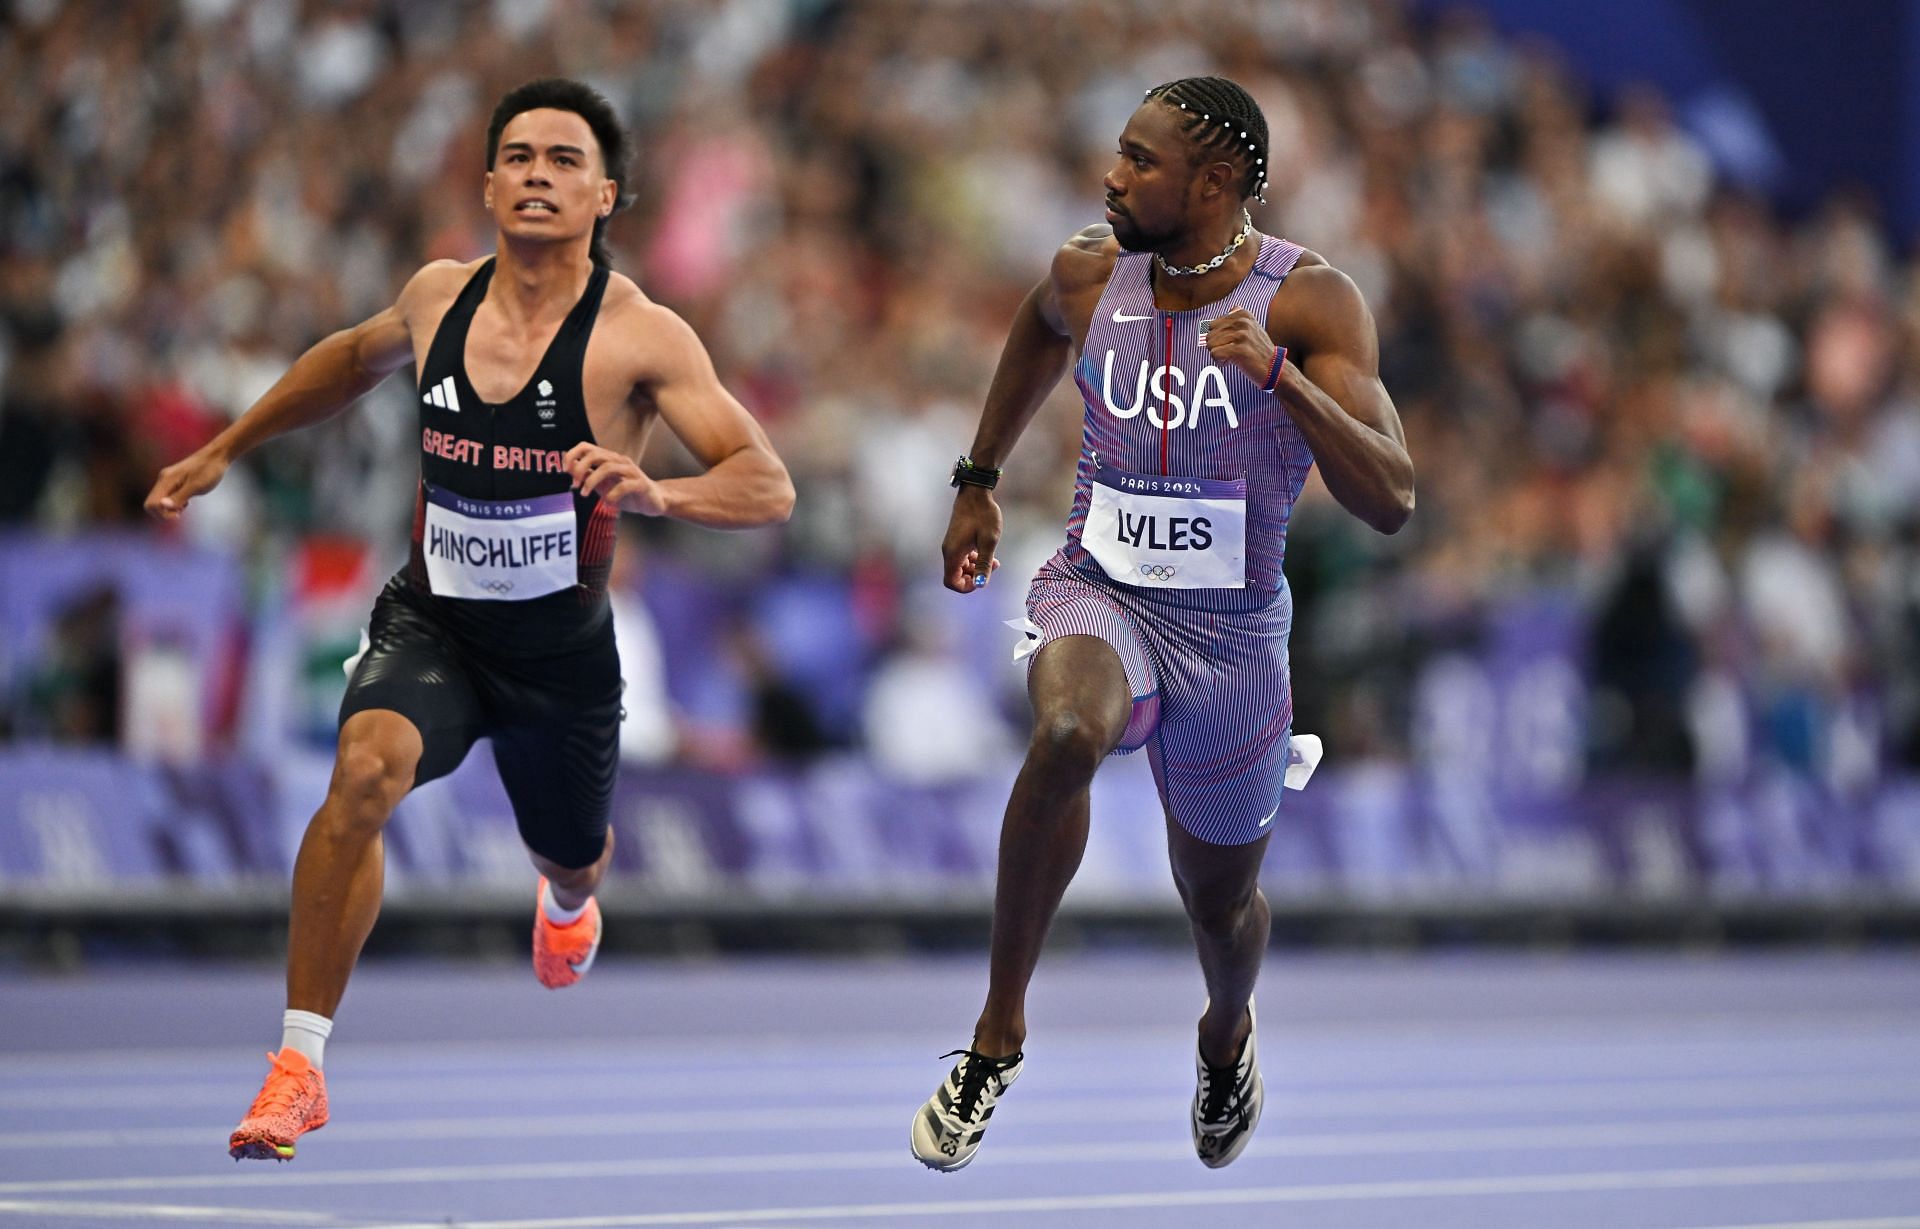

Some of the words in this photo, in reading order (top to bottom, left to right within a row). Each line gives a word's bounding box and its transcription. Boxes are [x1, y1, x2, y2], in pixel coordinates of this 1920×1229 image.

[1103, 350, 1239, 430] USA
[423, 427, 484, 466] GREAT
[493, 445, 568, 473] BRITA
[1121, 477, 1158, 491] PARIS
[1164, 482, 1201, 493] 2024
[457, 500, 491, 515] PARIS
[495, 504, 531, 515] 2024
[429, 524, 572, 568] HINCHLIFFE
[1117, 508, 1213, 551] LYLES
